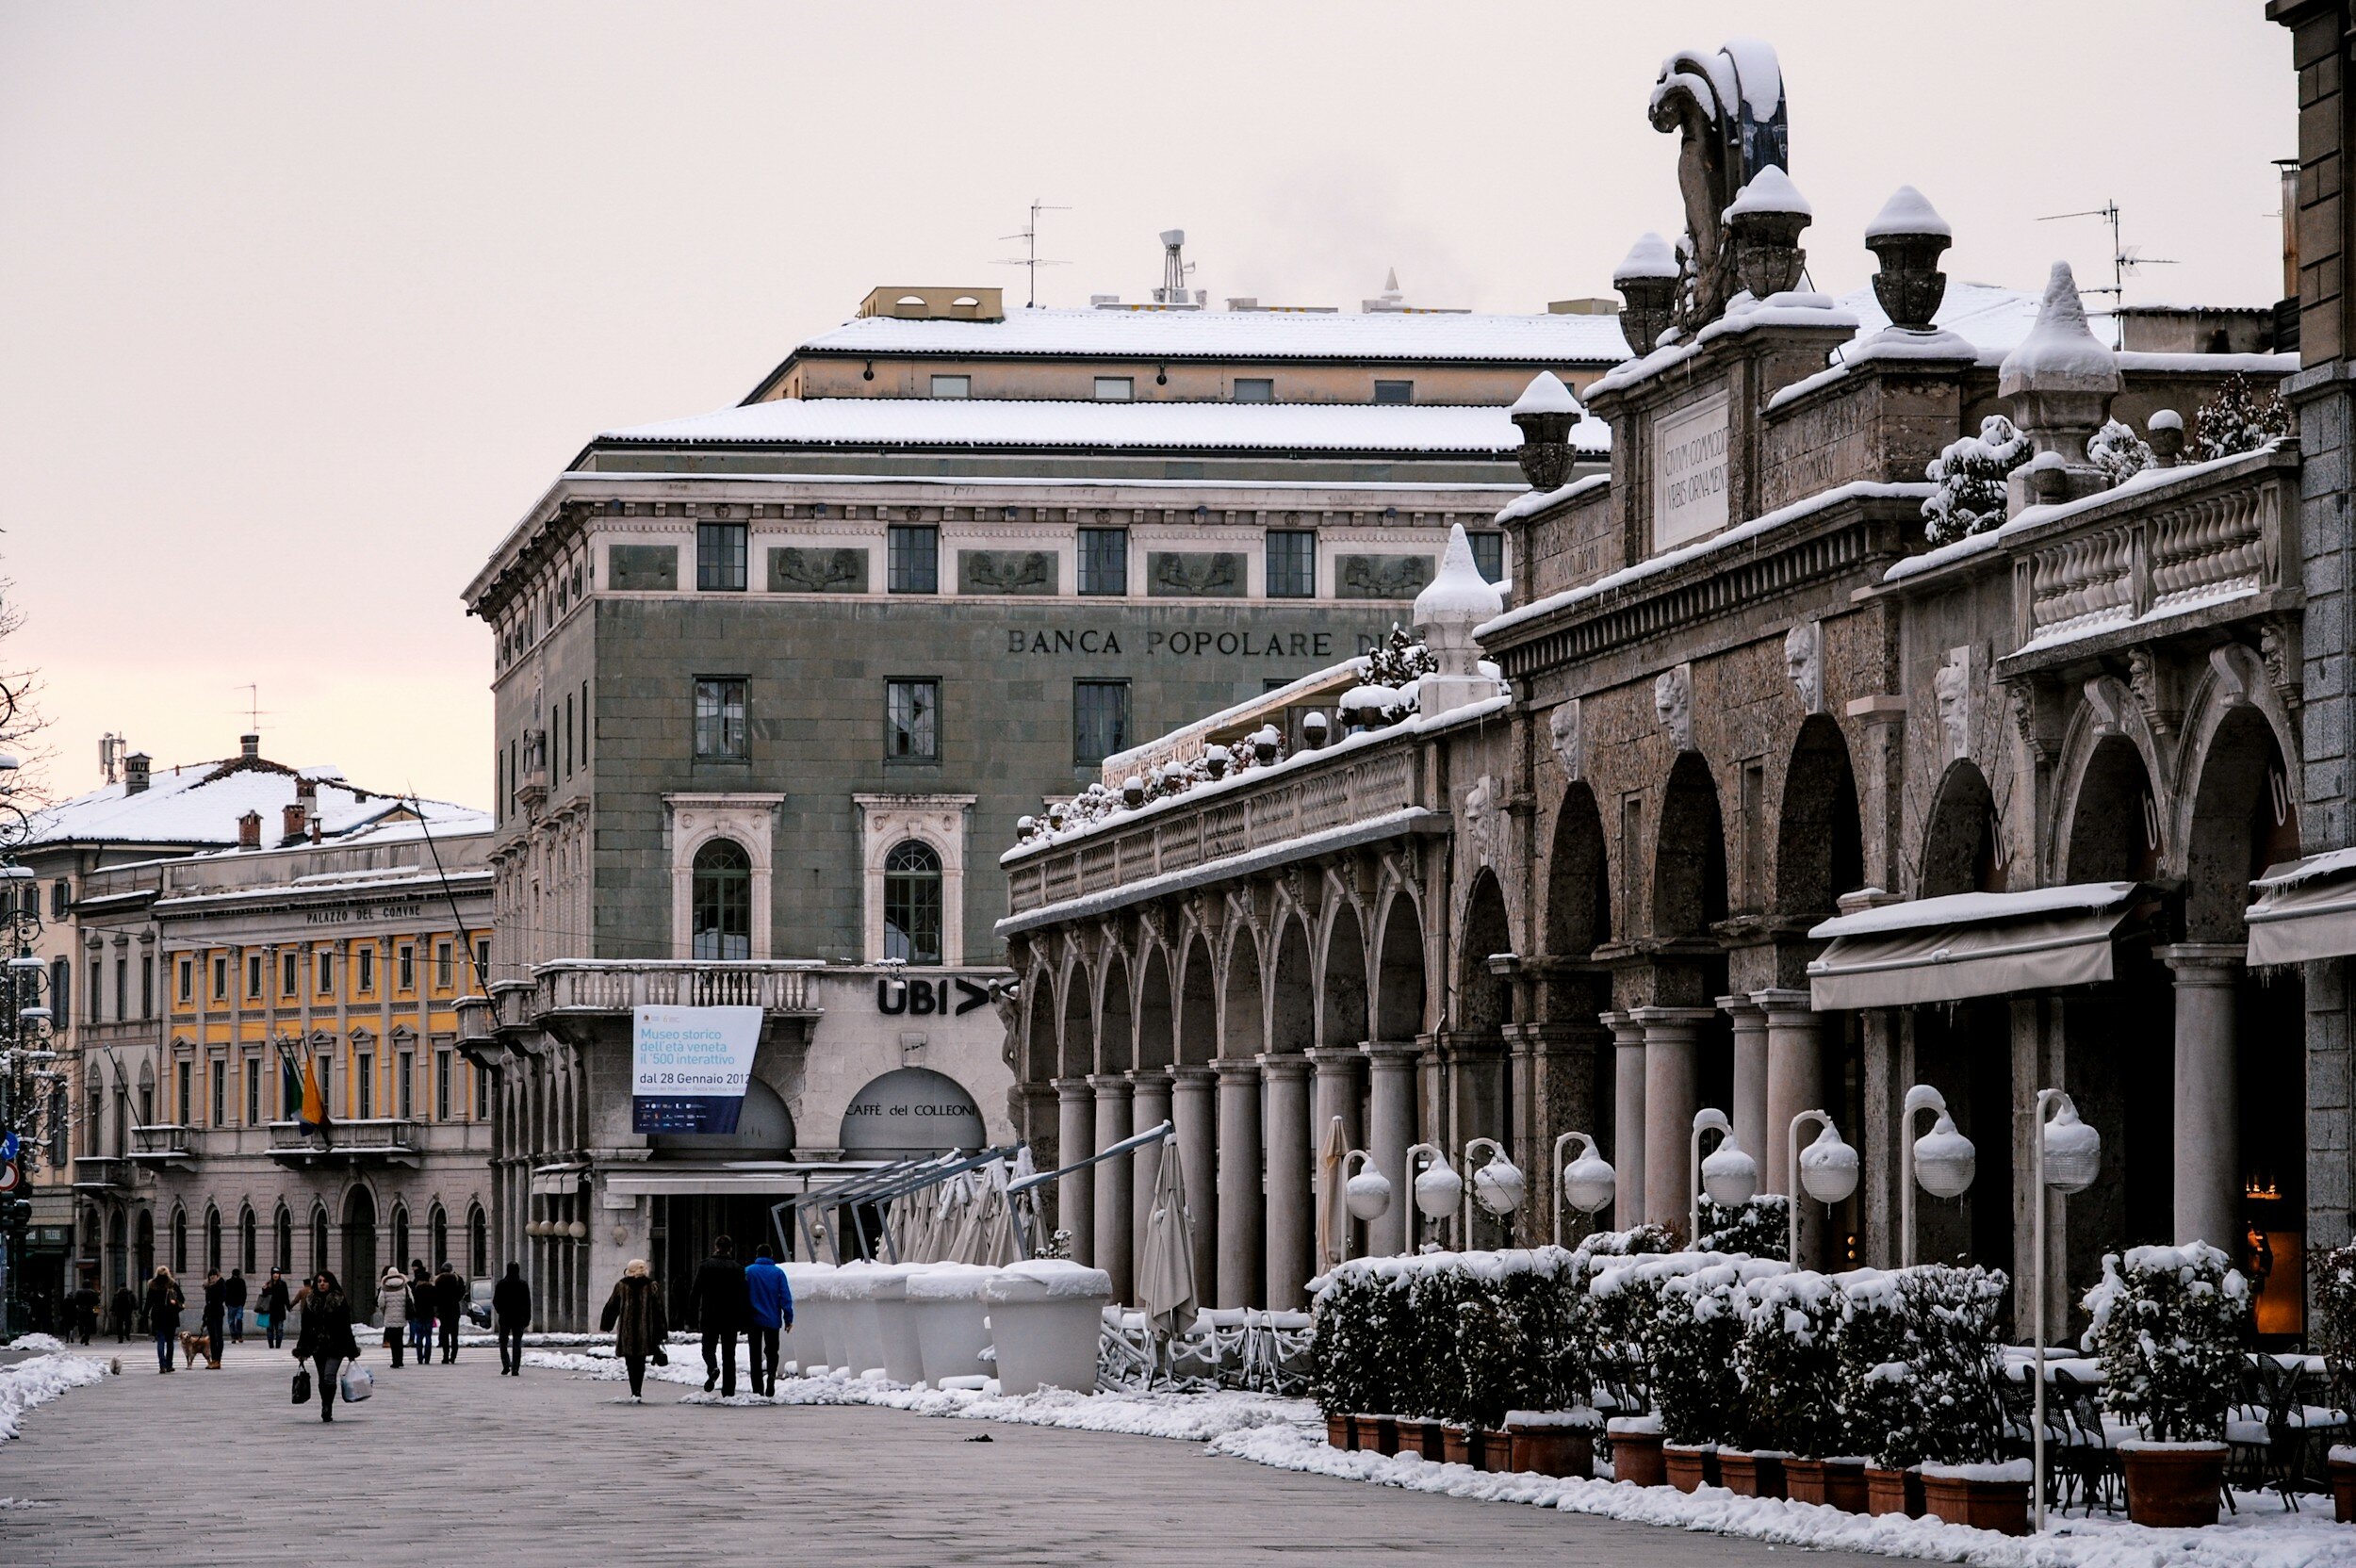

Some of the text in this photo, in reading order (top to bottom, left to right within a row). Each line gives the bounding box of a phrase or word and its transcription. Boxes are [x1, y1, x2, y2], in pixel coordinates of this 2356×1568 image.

[1667, 480, 1687, 511] VRBIS
[1007, 629, 1122, 656] BANCA
[1146, 630, 1333, 658] POPOLARE
[1357, 633, 1384, 657] DI
[306, 905, 421, 924] PALAZZO DEL COMVNE
[878, 979, 948, 1015] UBI
[641, 1028, 722, 1039] Museo storico
[640, 1040, 728, 1053] dell'età veneta
[640, 1054, 735, 1065] il '500 interattivo
[639, 1073, 657, 1084] dal
[660, 1073, 674, 1084] 28
[677, 1073, 724, 1084] Gennaio
[845, 1102, 975, 1116] CAFFÈ del COLLEONI
